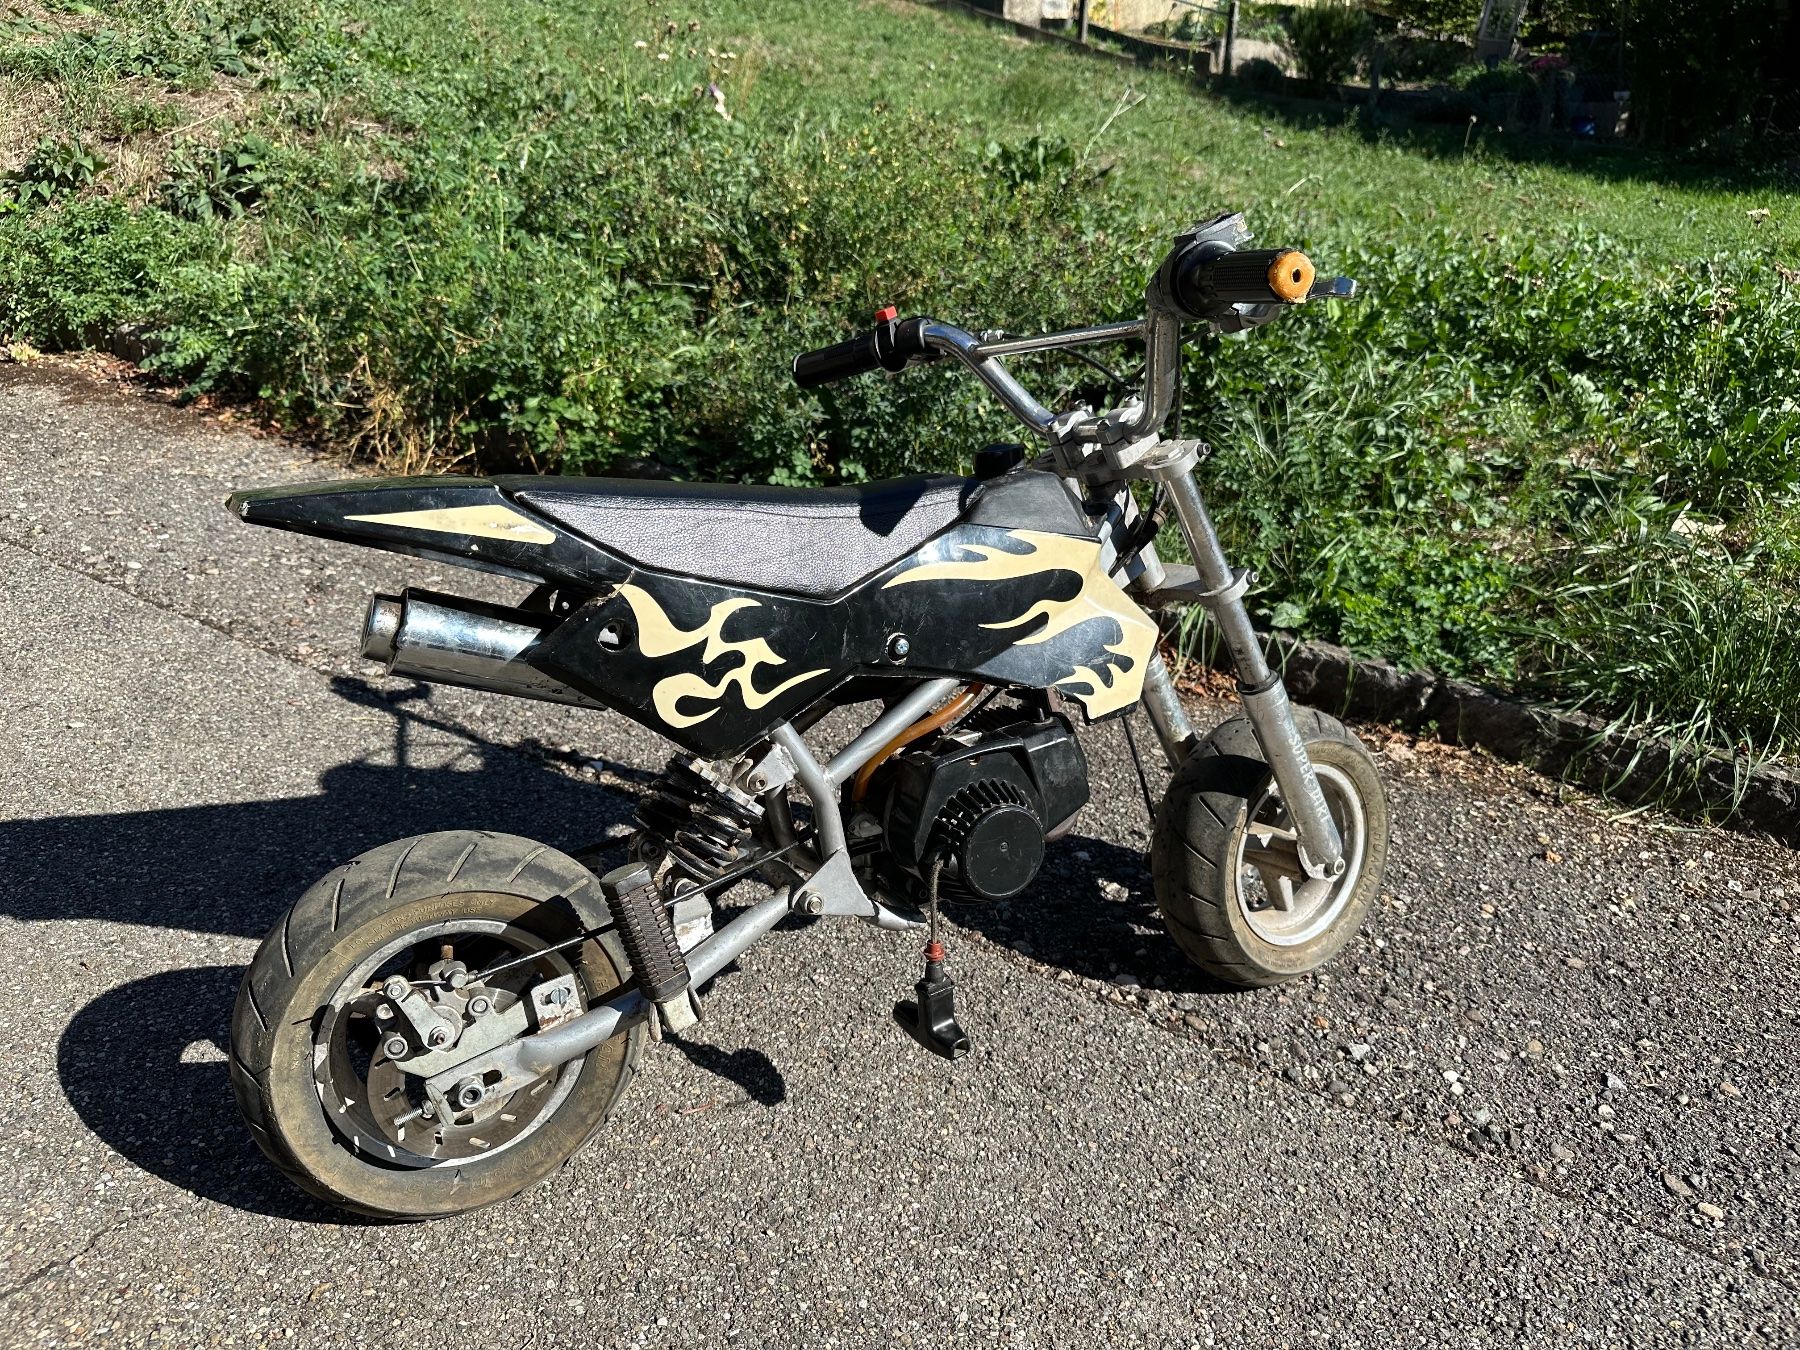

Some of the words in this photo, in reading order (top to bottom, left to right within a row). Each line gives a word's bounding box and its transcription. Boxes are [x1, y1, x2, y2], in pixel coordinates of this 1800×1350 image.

[1288, 733, 1314, 783] SUPER
[366, 934, 385, 948] NOT
[463, 906, 483, 914] USE
[412, 899, 465, 915] PURPOSES
